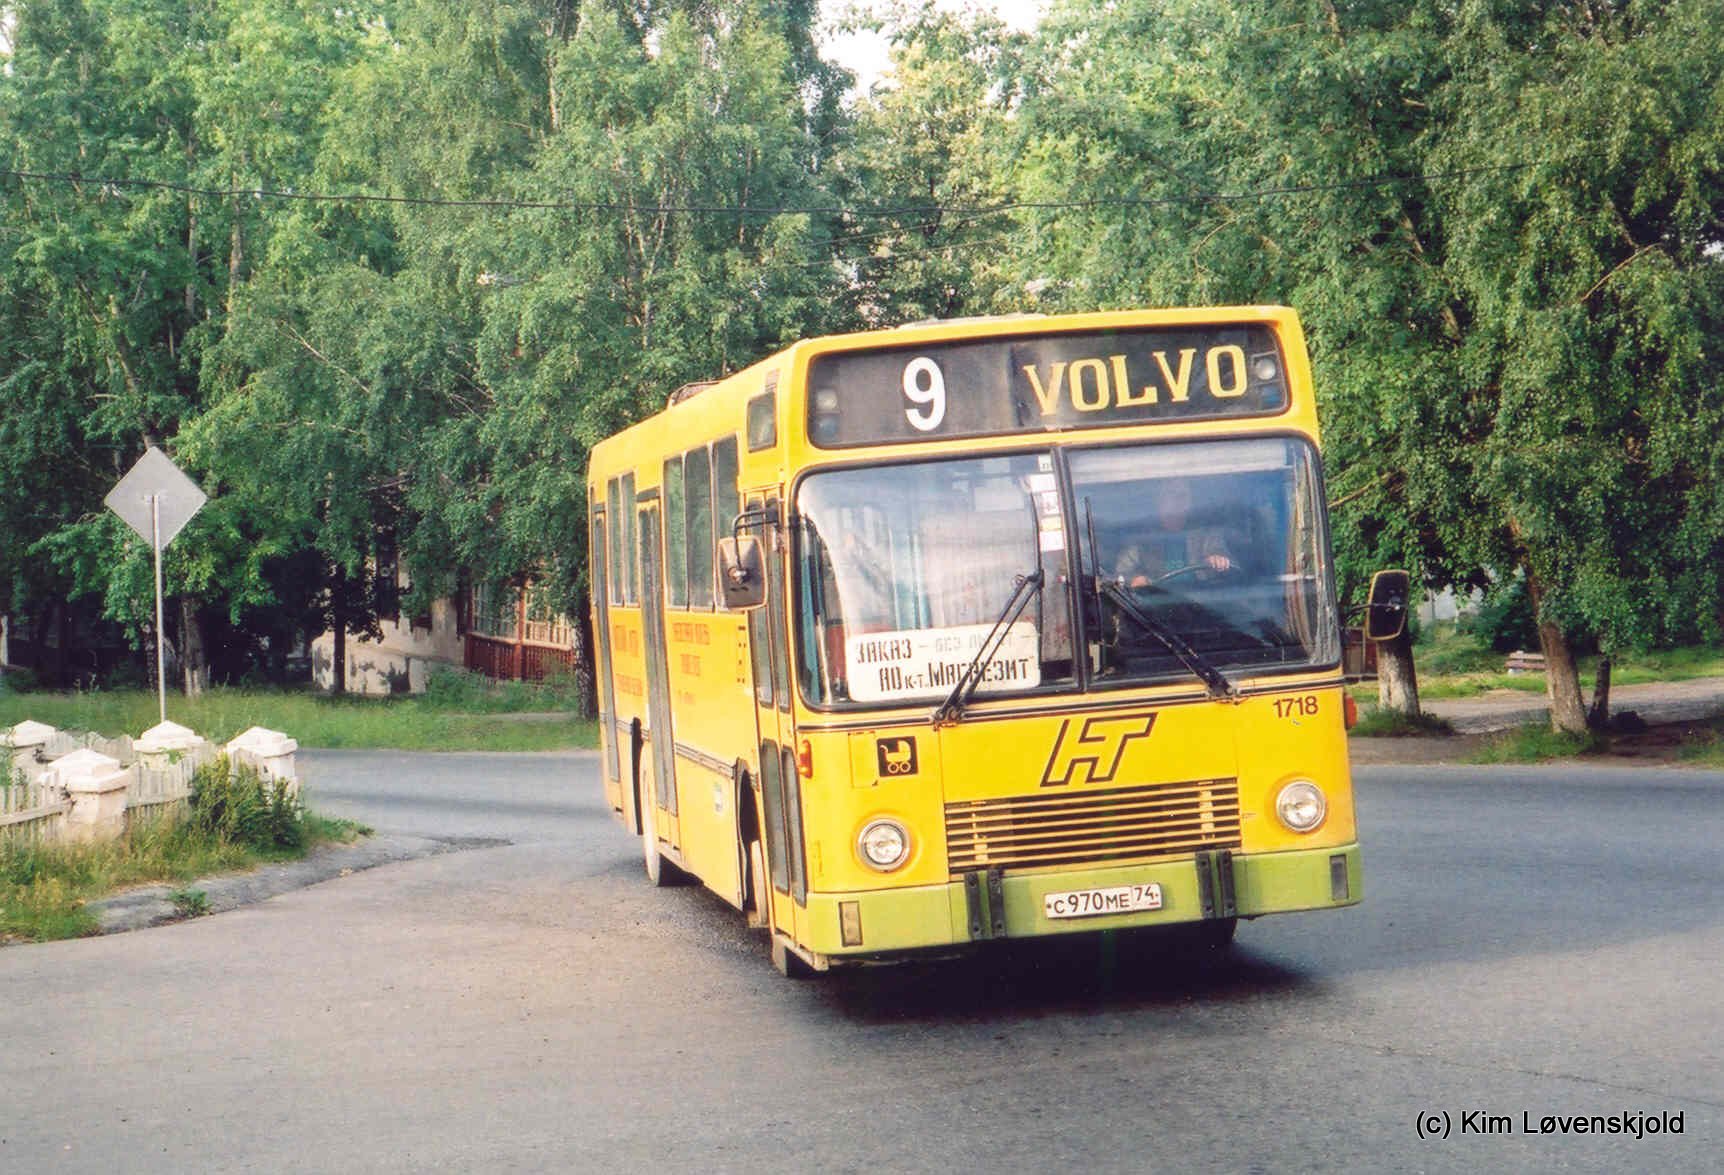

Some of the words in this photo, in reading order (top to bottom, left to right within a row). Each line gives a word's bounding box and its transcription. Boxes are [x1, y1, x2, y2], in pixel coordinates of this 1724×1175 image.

[902, 356, 947, 432] 9
[1022, 344, 1248, 418] VOLVO
[855, 638, 912, 664] ЗАКАЗ
[1272, 696, 1319, 719] 1718
[1053, 892, 1130, 914] С970МЕ
[1134, 886, 1154, 902] 74
